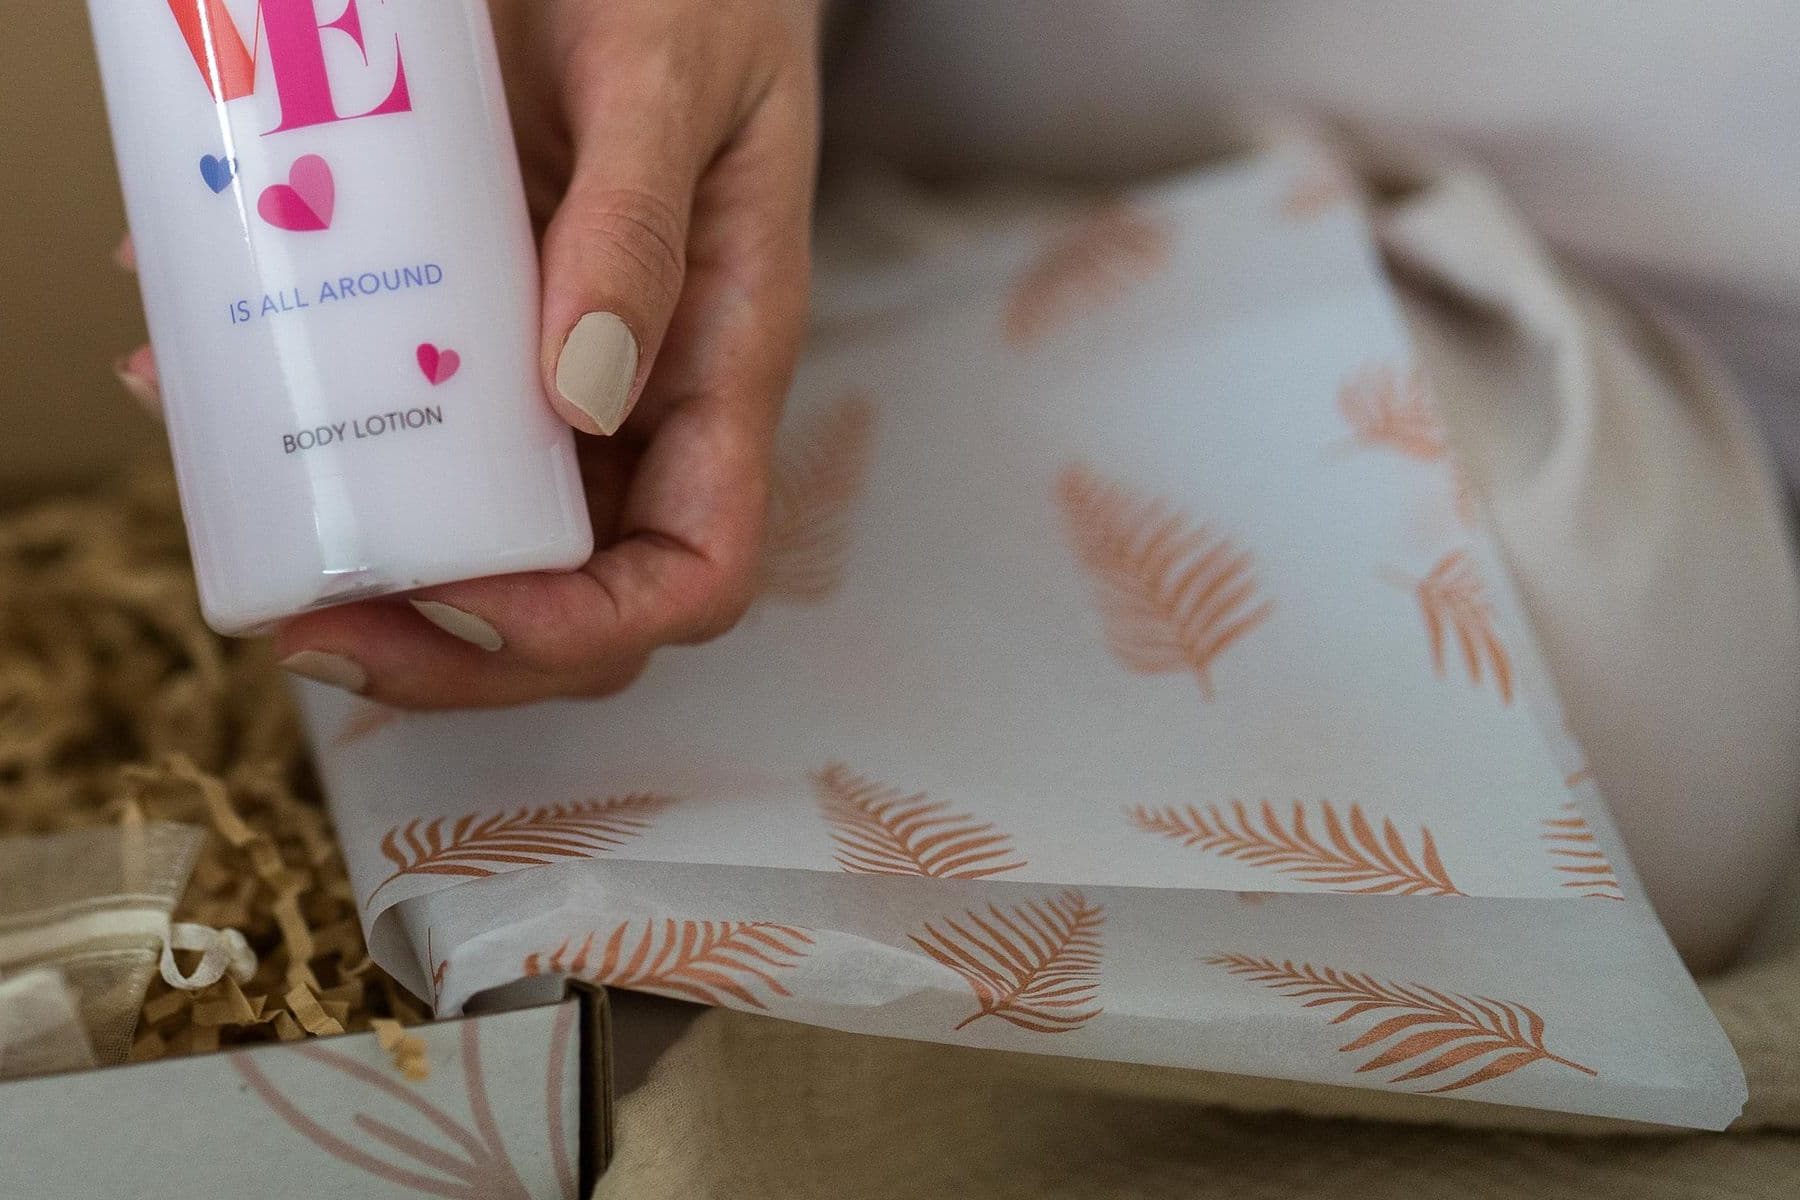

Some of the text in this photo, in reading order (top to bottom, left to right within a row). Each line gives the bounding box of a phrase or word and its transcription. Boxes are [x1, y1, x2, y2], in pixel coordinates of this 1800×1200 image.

[229, 264, 443, 324] IS ALL AROUND
[283, 405, 443, 454] BODY LOTION
